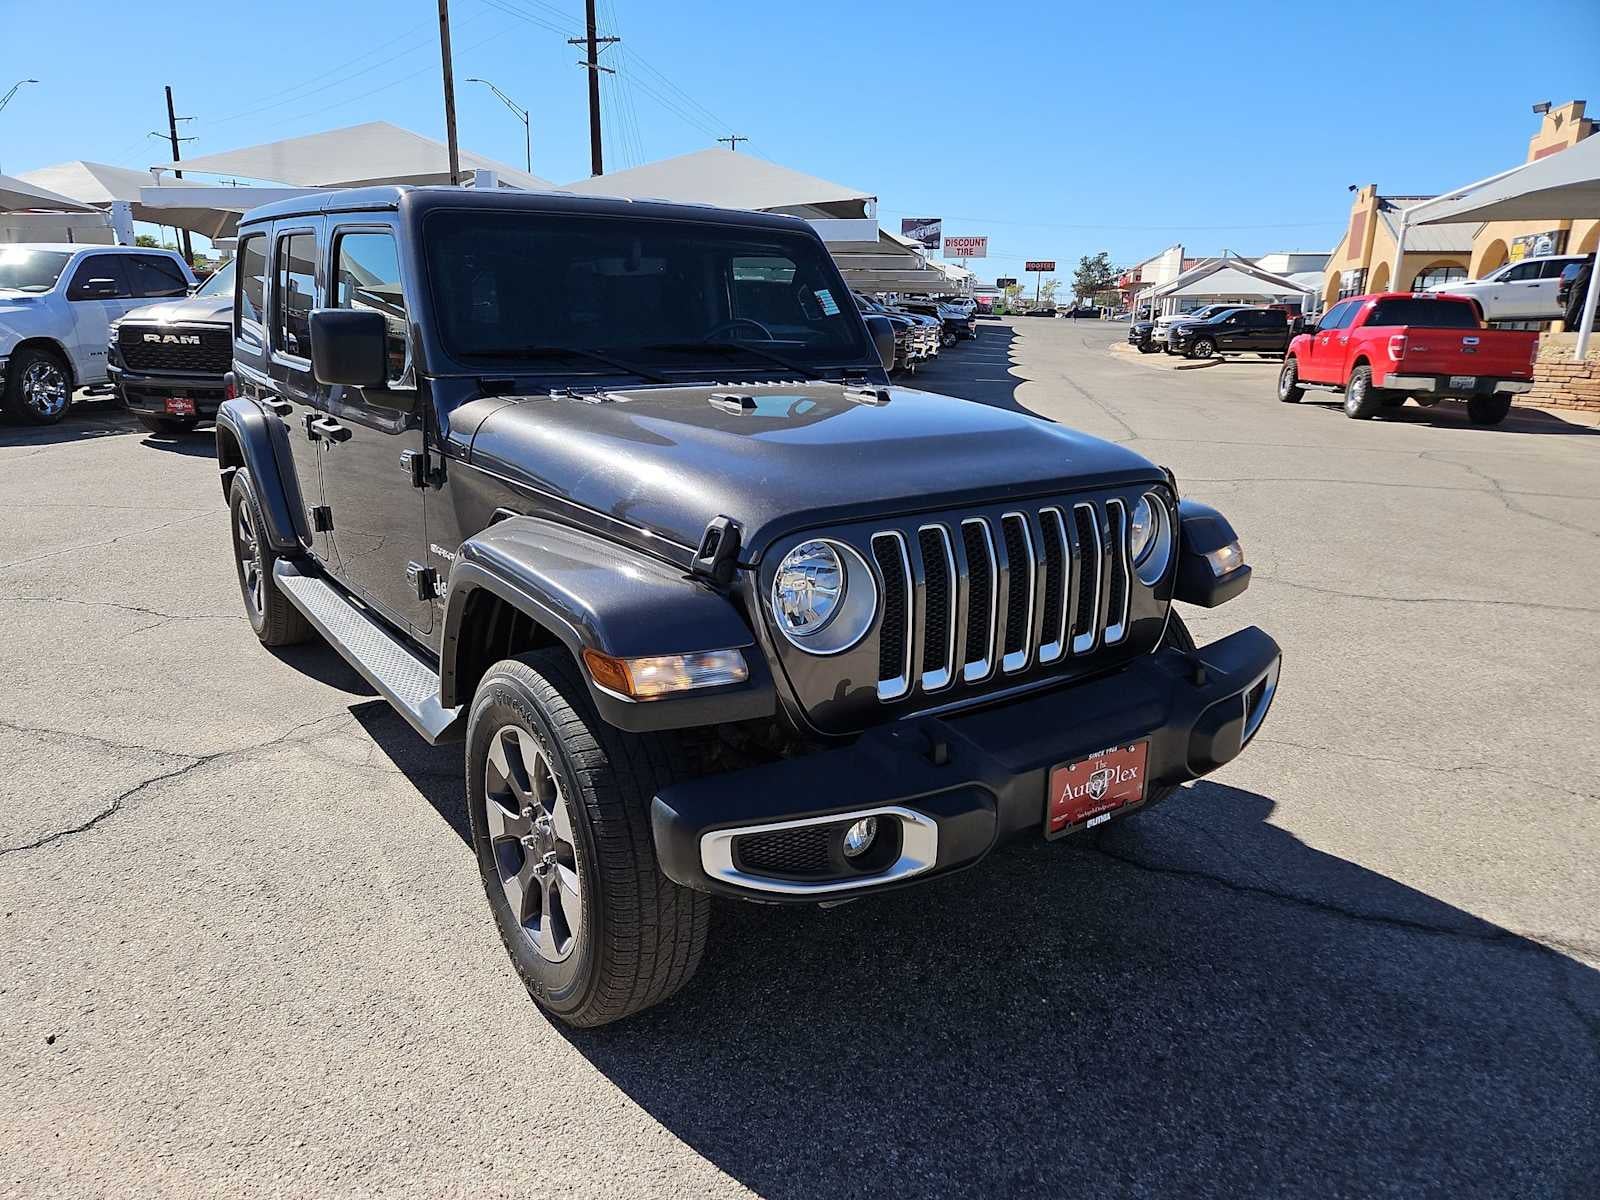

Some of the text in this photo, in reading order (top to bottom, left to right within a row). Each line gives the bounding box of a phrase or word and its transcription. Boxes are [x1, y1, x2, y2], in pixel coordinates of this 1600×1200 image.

[945, 238, 985, 247] DISCOUNT
[956, 247, 974, 256] TIRE
[1026, 262, 1054, 270] HOOTERS
[143, 333, 200, 345] RAM
[433, 574, 448, 598] Je
[1088, 748, 1105, 760] SINCE
[1095, 760, 1108, 770] The
[1059, 765, 1139, 804] AutoPlex
